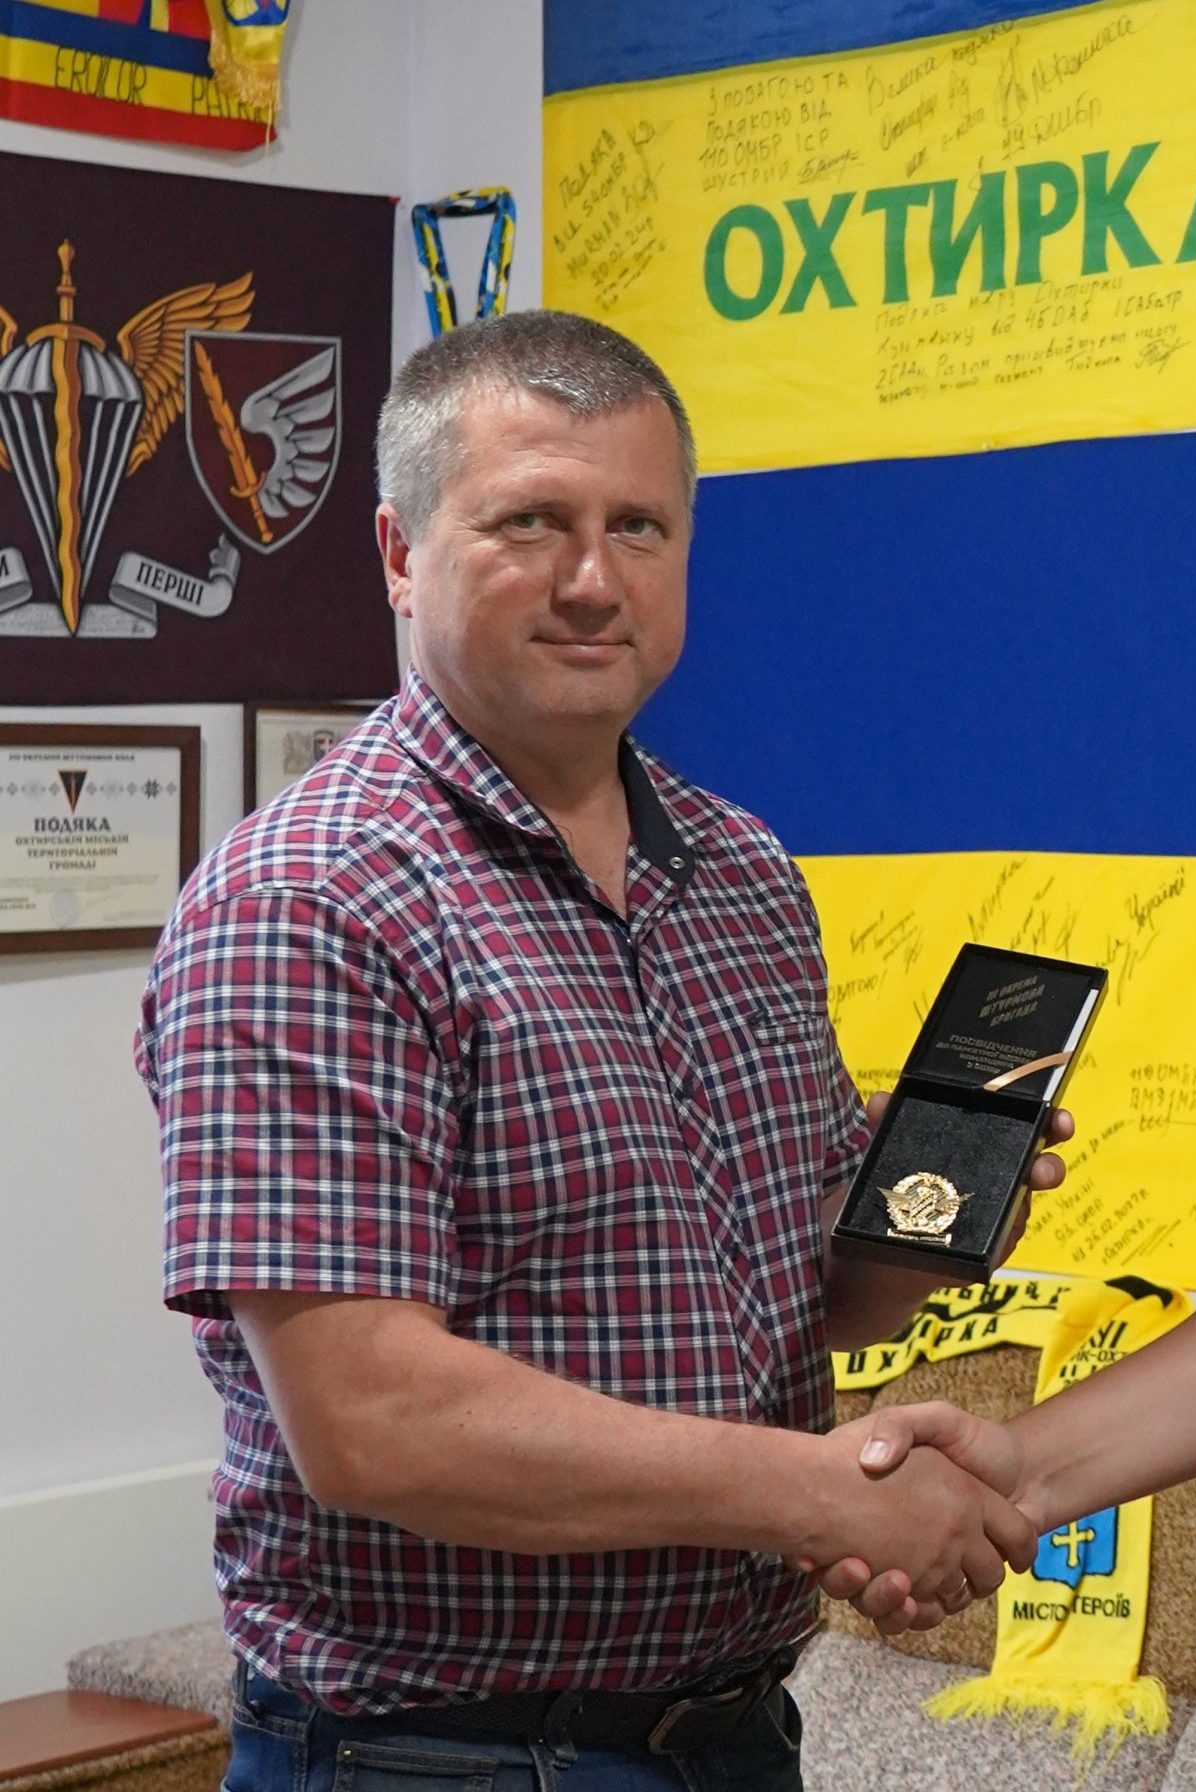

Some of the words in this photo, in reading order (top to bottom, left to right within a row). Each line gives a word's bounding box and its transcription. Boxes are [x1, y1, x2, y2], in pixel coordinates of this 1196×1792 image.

[135, 561, 204, 606] ПЕРШІ
[34, 817, 111, 833] ПОДЯКА
[950, 1033, 1038, 1058] ПОСВІДЧЕННЯ
[1012, 1600, 1068, 1621] МІСТО
[1071, 1593, 1131, 1618] ГЕРОЇВ
